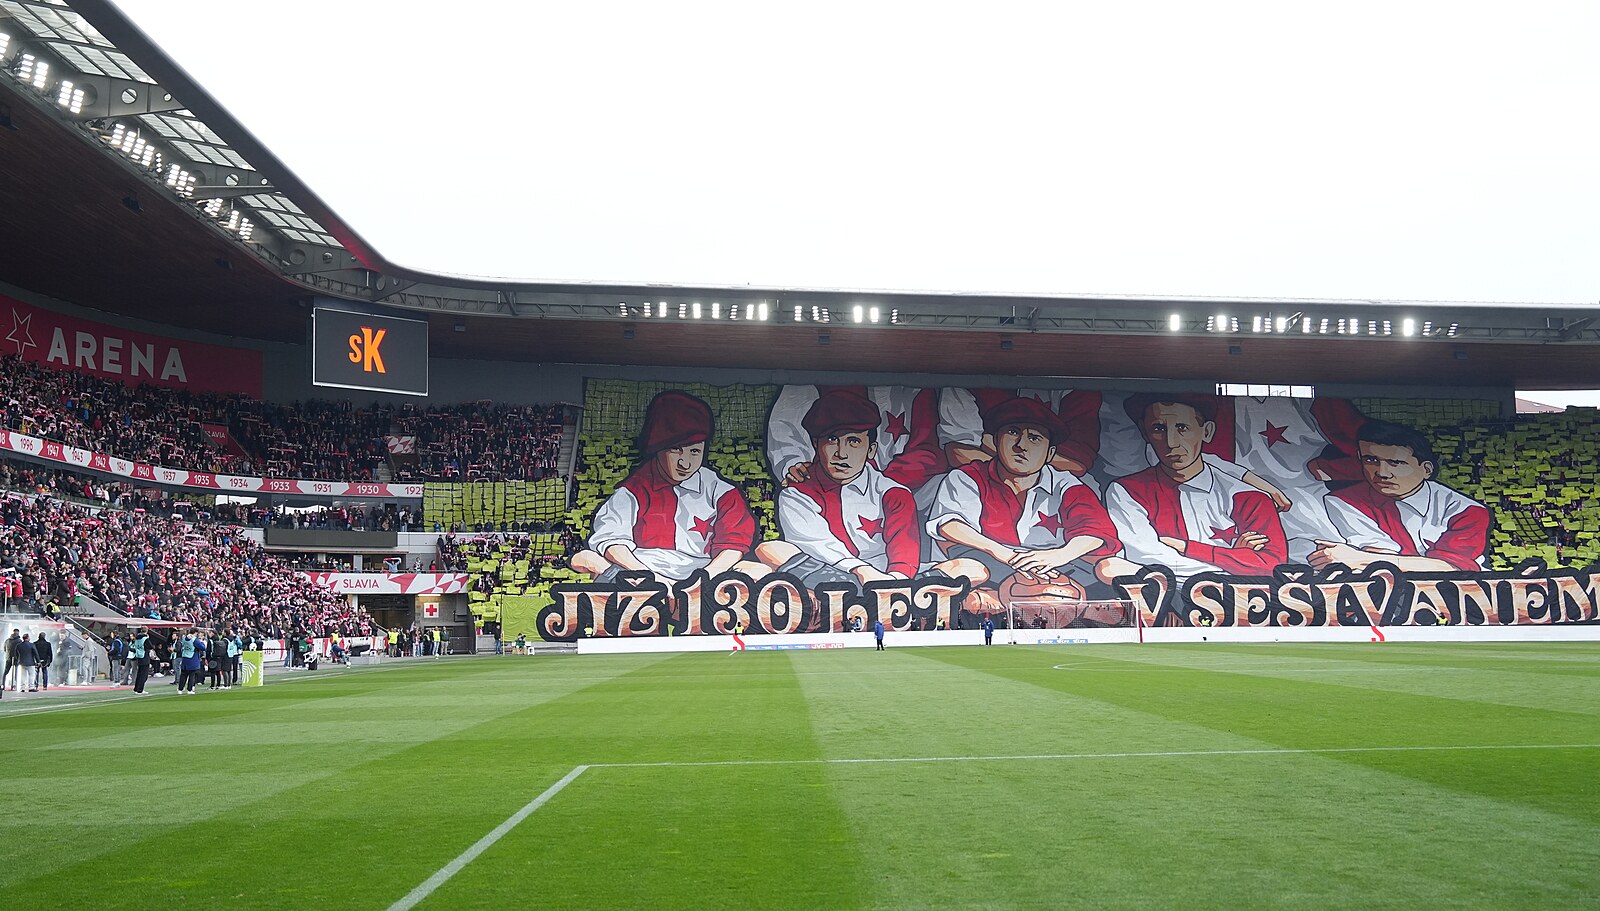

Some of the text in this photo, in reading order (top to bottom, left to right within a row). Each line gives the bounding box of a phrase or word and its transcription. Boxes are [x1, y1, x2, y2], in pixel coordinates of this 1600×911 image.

[47, 327, 188, 383] ARENA
[47, 444, 59, 457] 1947
[137, 467, 150, 477] 1940
[193, 475, 210, 485] 1935
[229, 477, 249, 488] 1934
[269, 480, 290, 491] 1933
[312, 483, 332, 492] 1931
[356, 484, 379, 494] 1930
[404, 486, 425, 495] 192
[342, 579, 380, 589] SLAVIA
[545, 578, 662, 638] JIŽ
[680, 576, 803, 636] 130
[823, 584, 965, 634] LET
[1119, 571, 1168, 628] V
